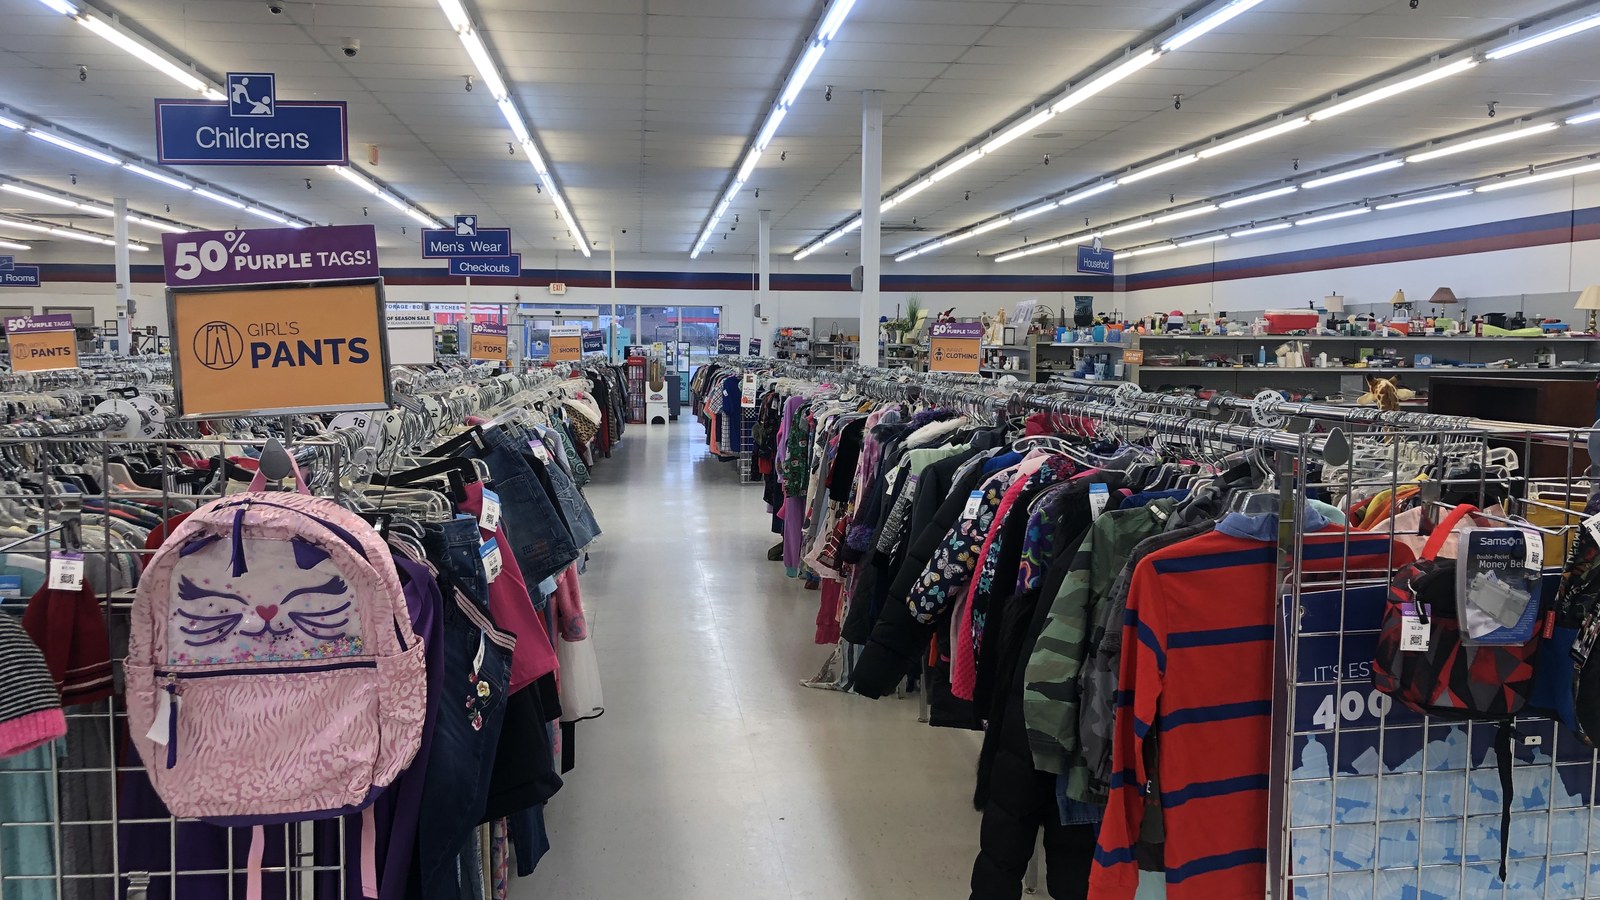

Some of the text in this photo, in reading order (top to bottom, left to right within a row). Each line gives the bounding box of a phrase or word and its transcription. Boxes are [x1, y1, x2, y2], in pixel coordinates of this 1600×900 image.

[195, 126, 310, 149] Childrens
[430, 241, 502, 253] Men's Wear
[175, 231, 371, 280] 50% PURPLE TAGS!
[459, 262, 510, 273] Checkouts
[1083, 257, 1110, 270] Household
[5, 273, 36, 282] Rooms
[552, 284, 563, 292] EXIT
[27, 321, 53, 329] PURPLE
[247, 321, 300, 337] GIRL'S
[31, 346, 71, 358] PANTS
[250, 337, 371, 368] PANTS
[483, 346, 503, 354] TOPS
[455, 388, 465, 396] 12
[148, 405, 159, 417] 16
[431, 407, 438, 418] 14
[353, 417, 366, 428] 18
[1480, 537, 1524, 547] Samsoni
[1478, 560, 1526, 570] Money Bel
[1314, 663, 1344, 682] IT'S
[1312, 690, 1392, 730] 400
